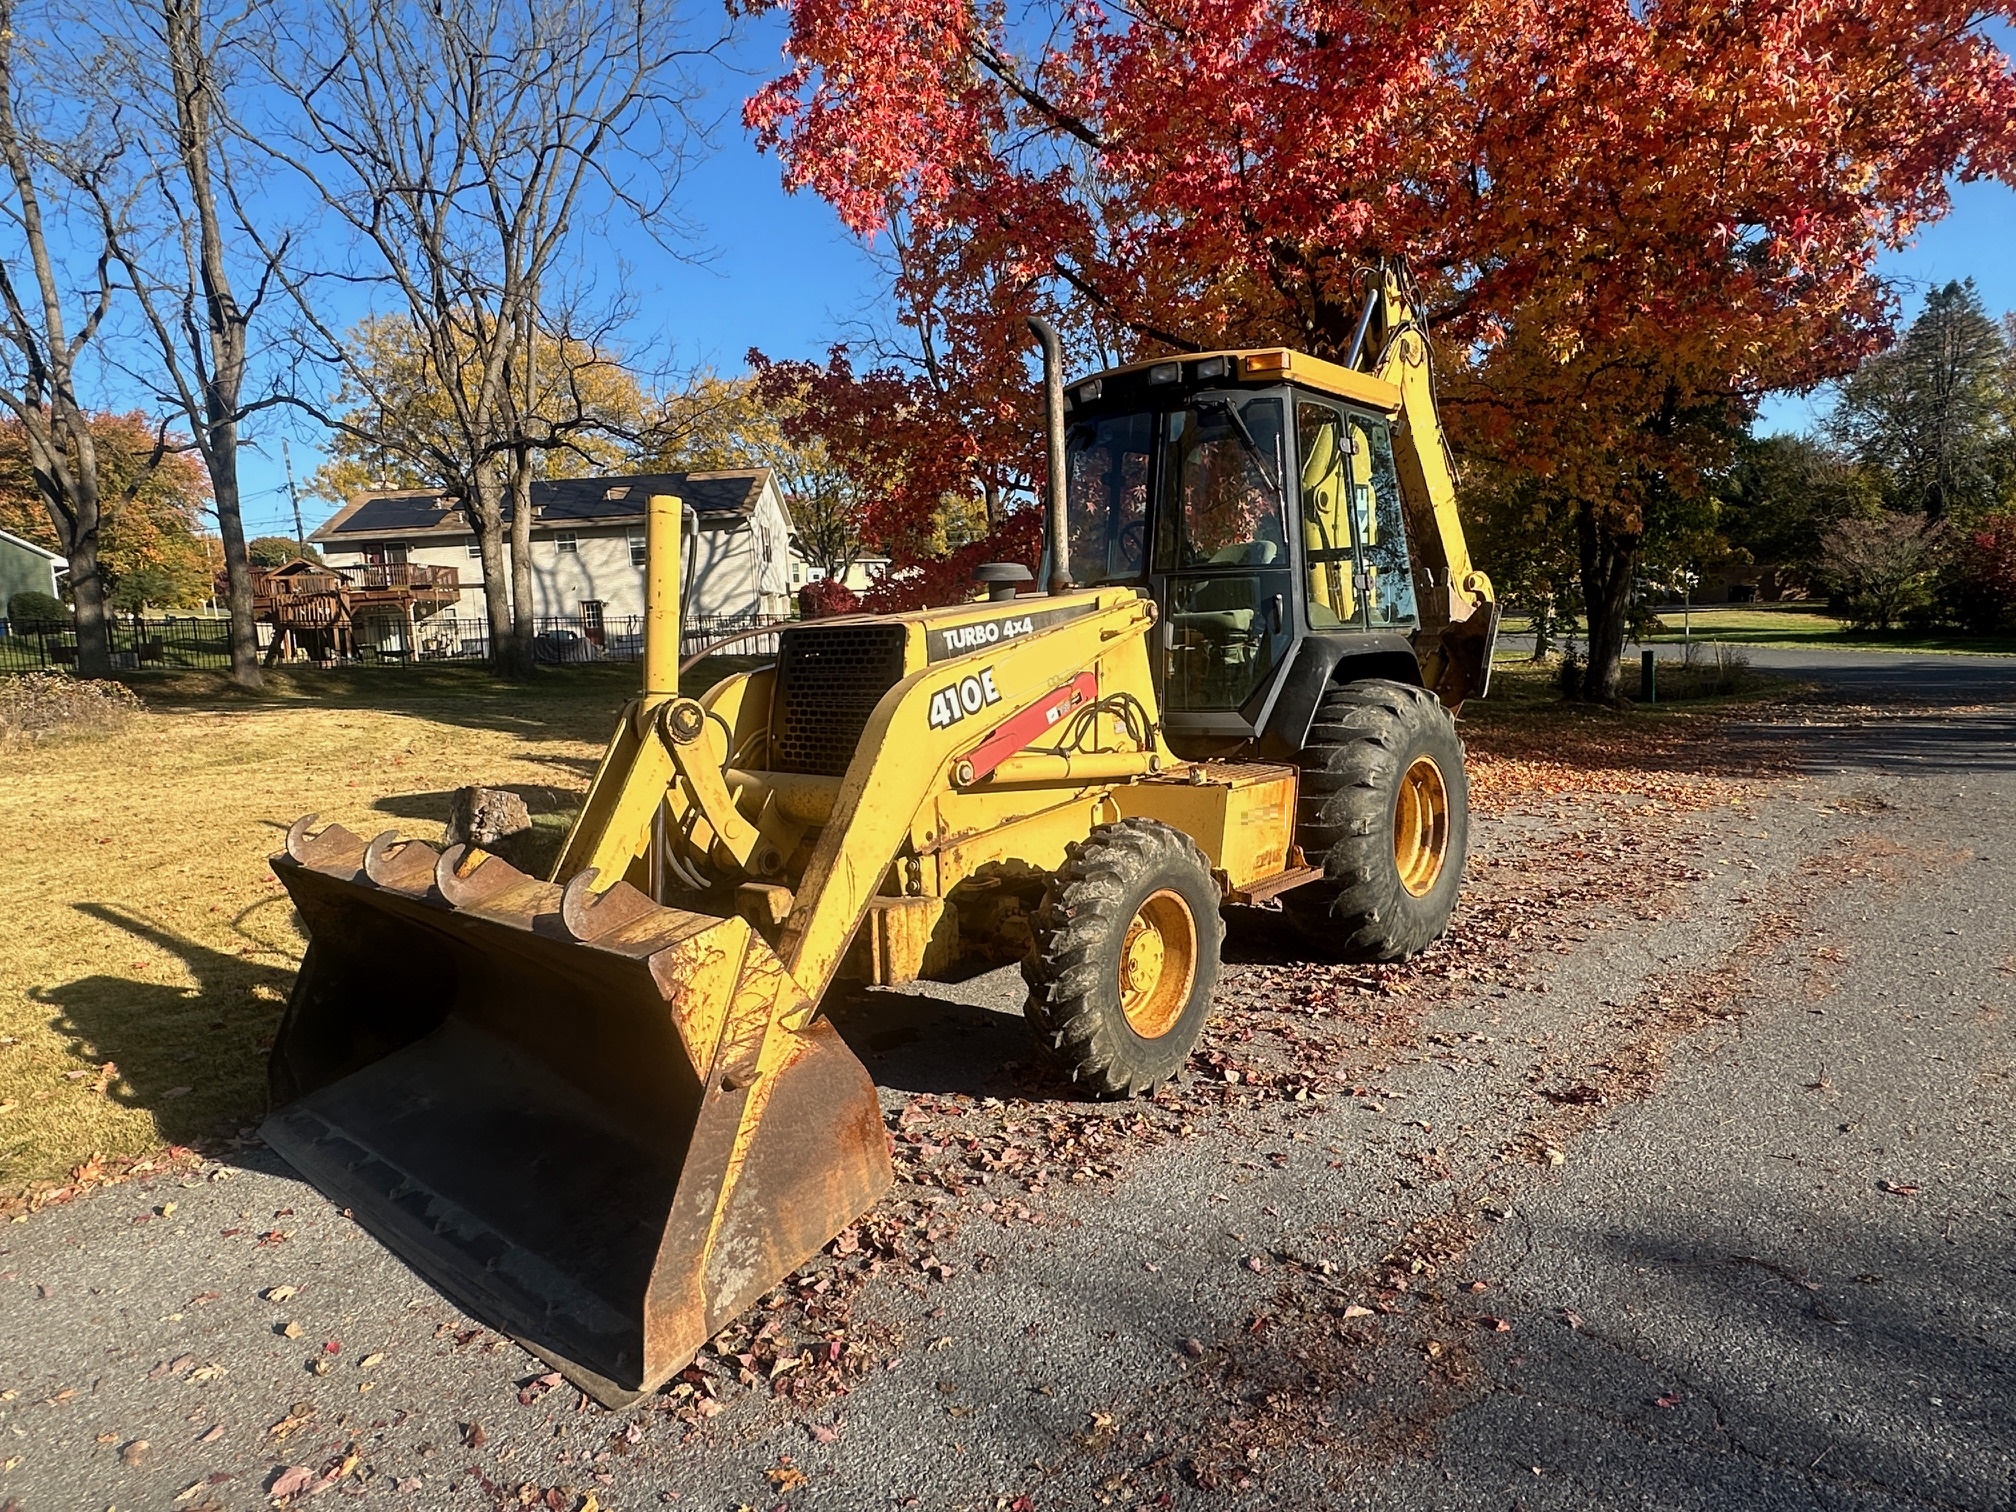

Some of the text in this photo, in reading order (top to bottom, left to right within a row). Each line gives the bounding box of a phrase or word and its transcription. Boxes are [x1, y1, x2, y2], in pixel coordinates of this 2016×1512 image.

[943, 616, 1034, 650] TURBO 4x4
[928, 665, 1002, 730] 410E
